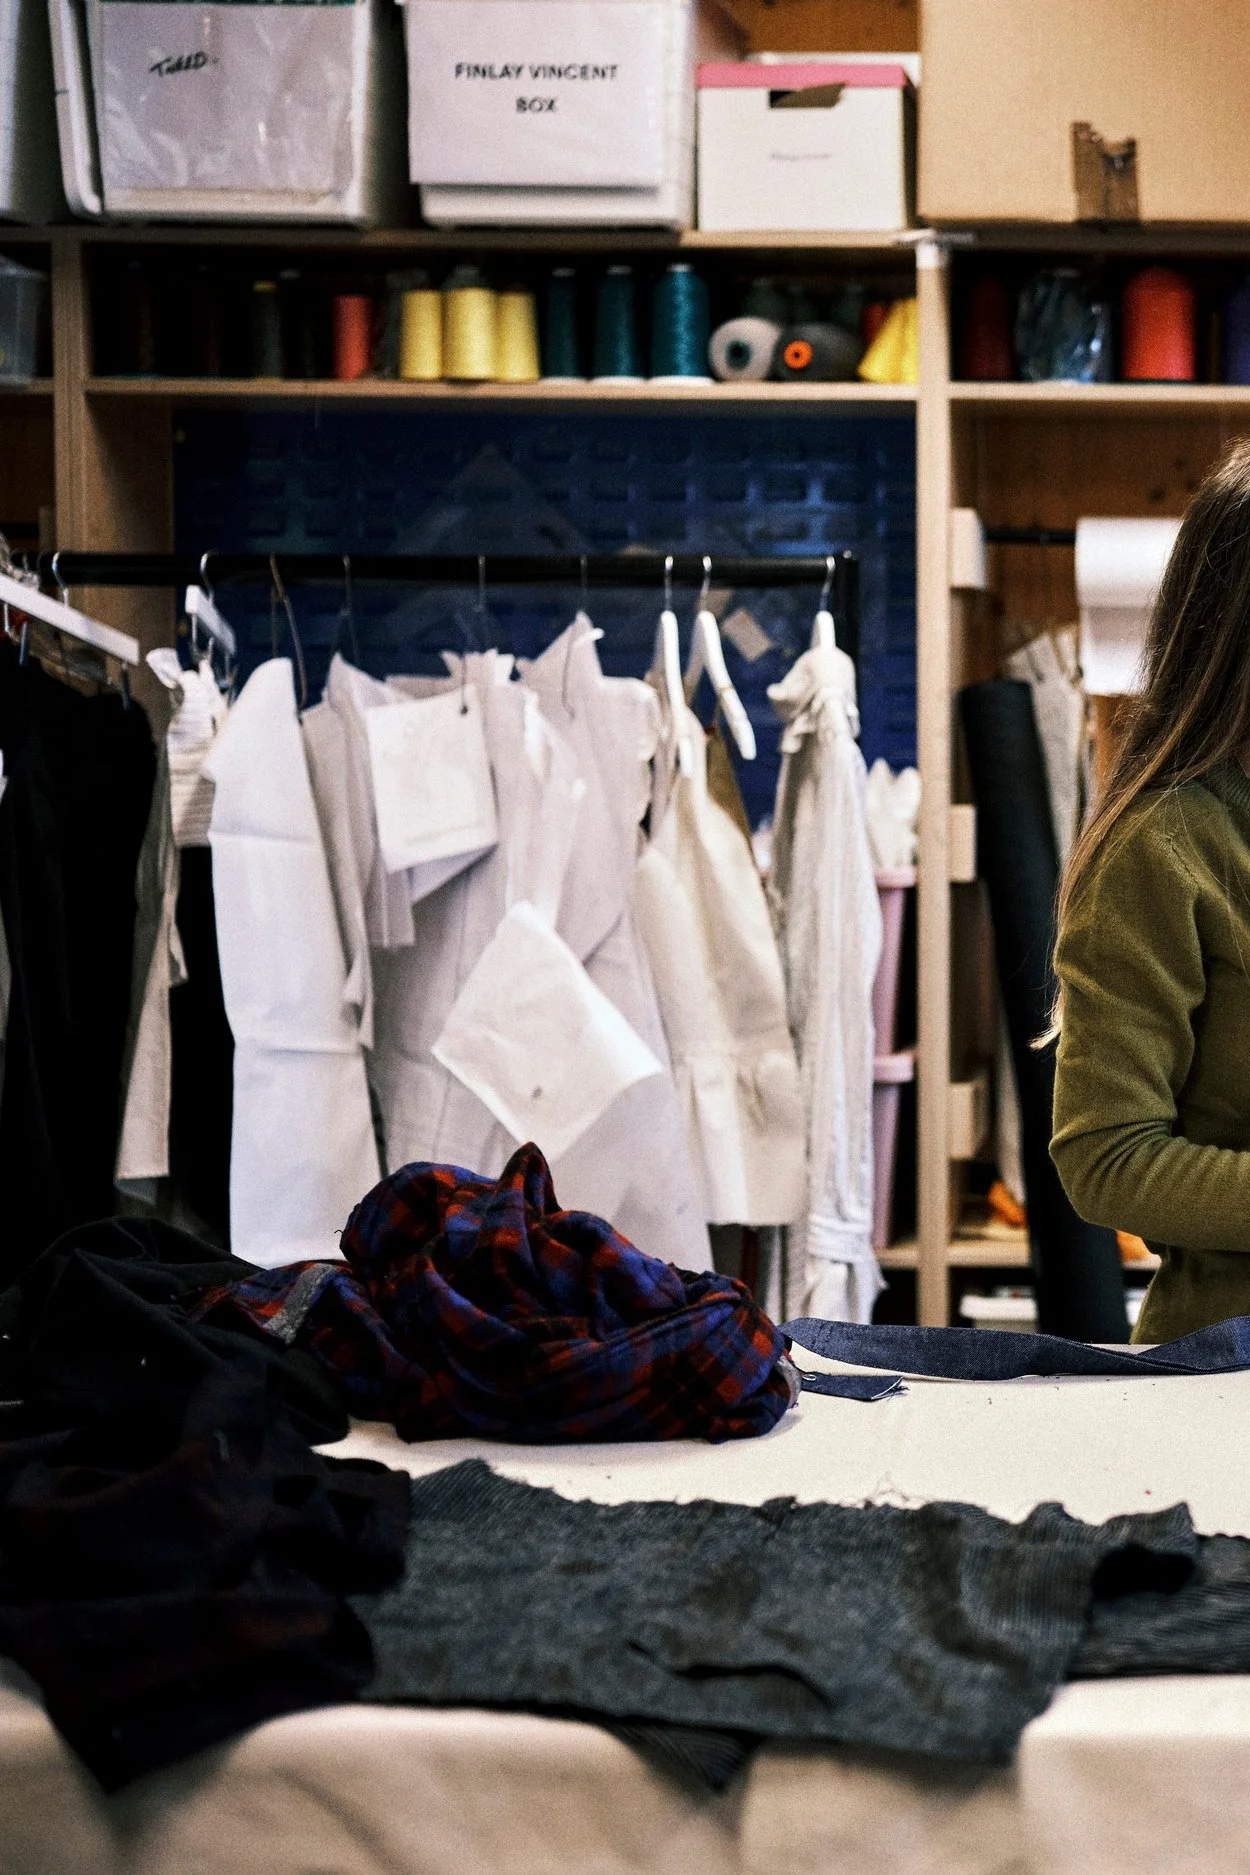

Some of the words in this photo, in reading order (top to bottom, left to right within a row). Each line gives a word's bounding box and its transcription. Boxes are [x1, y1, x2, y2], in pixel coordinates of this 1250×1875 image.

[454, 63, 524, 80] FINLAY
[527, 63, 619, 80] VINCENT
[515, 97, 557, 113] BOX
